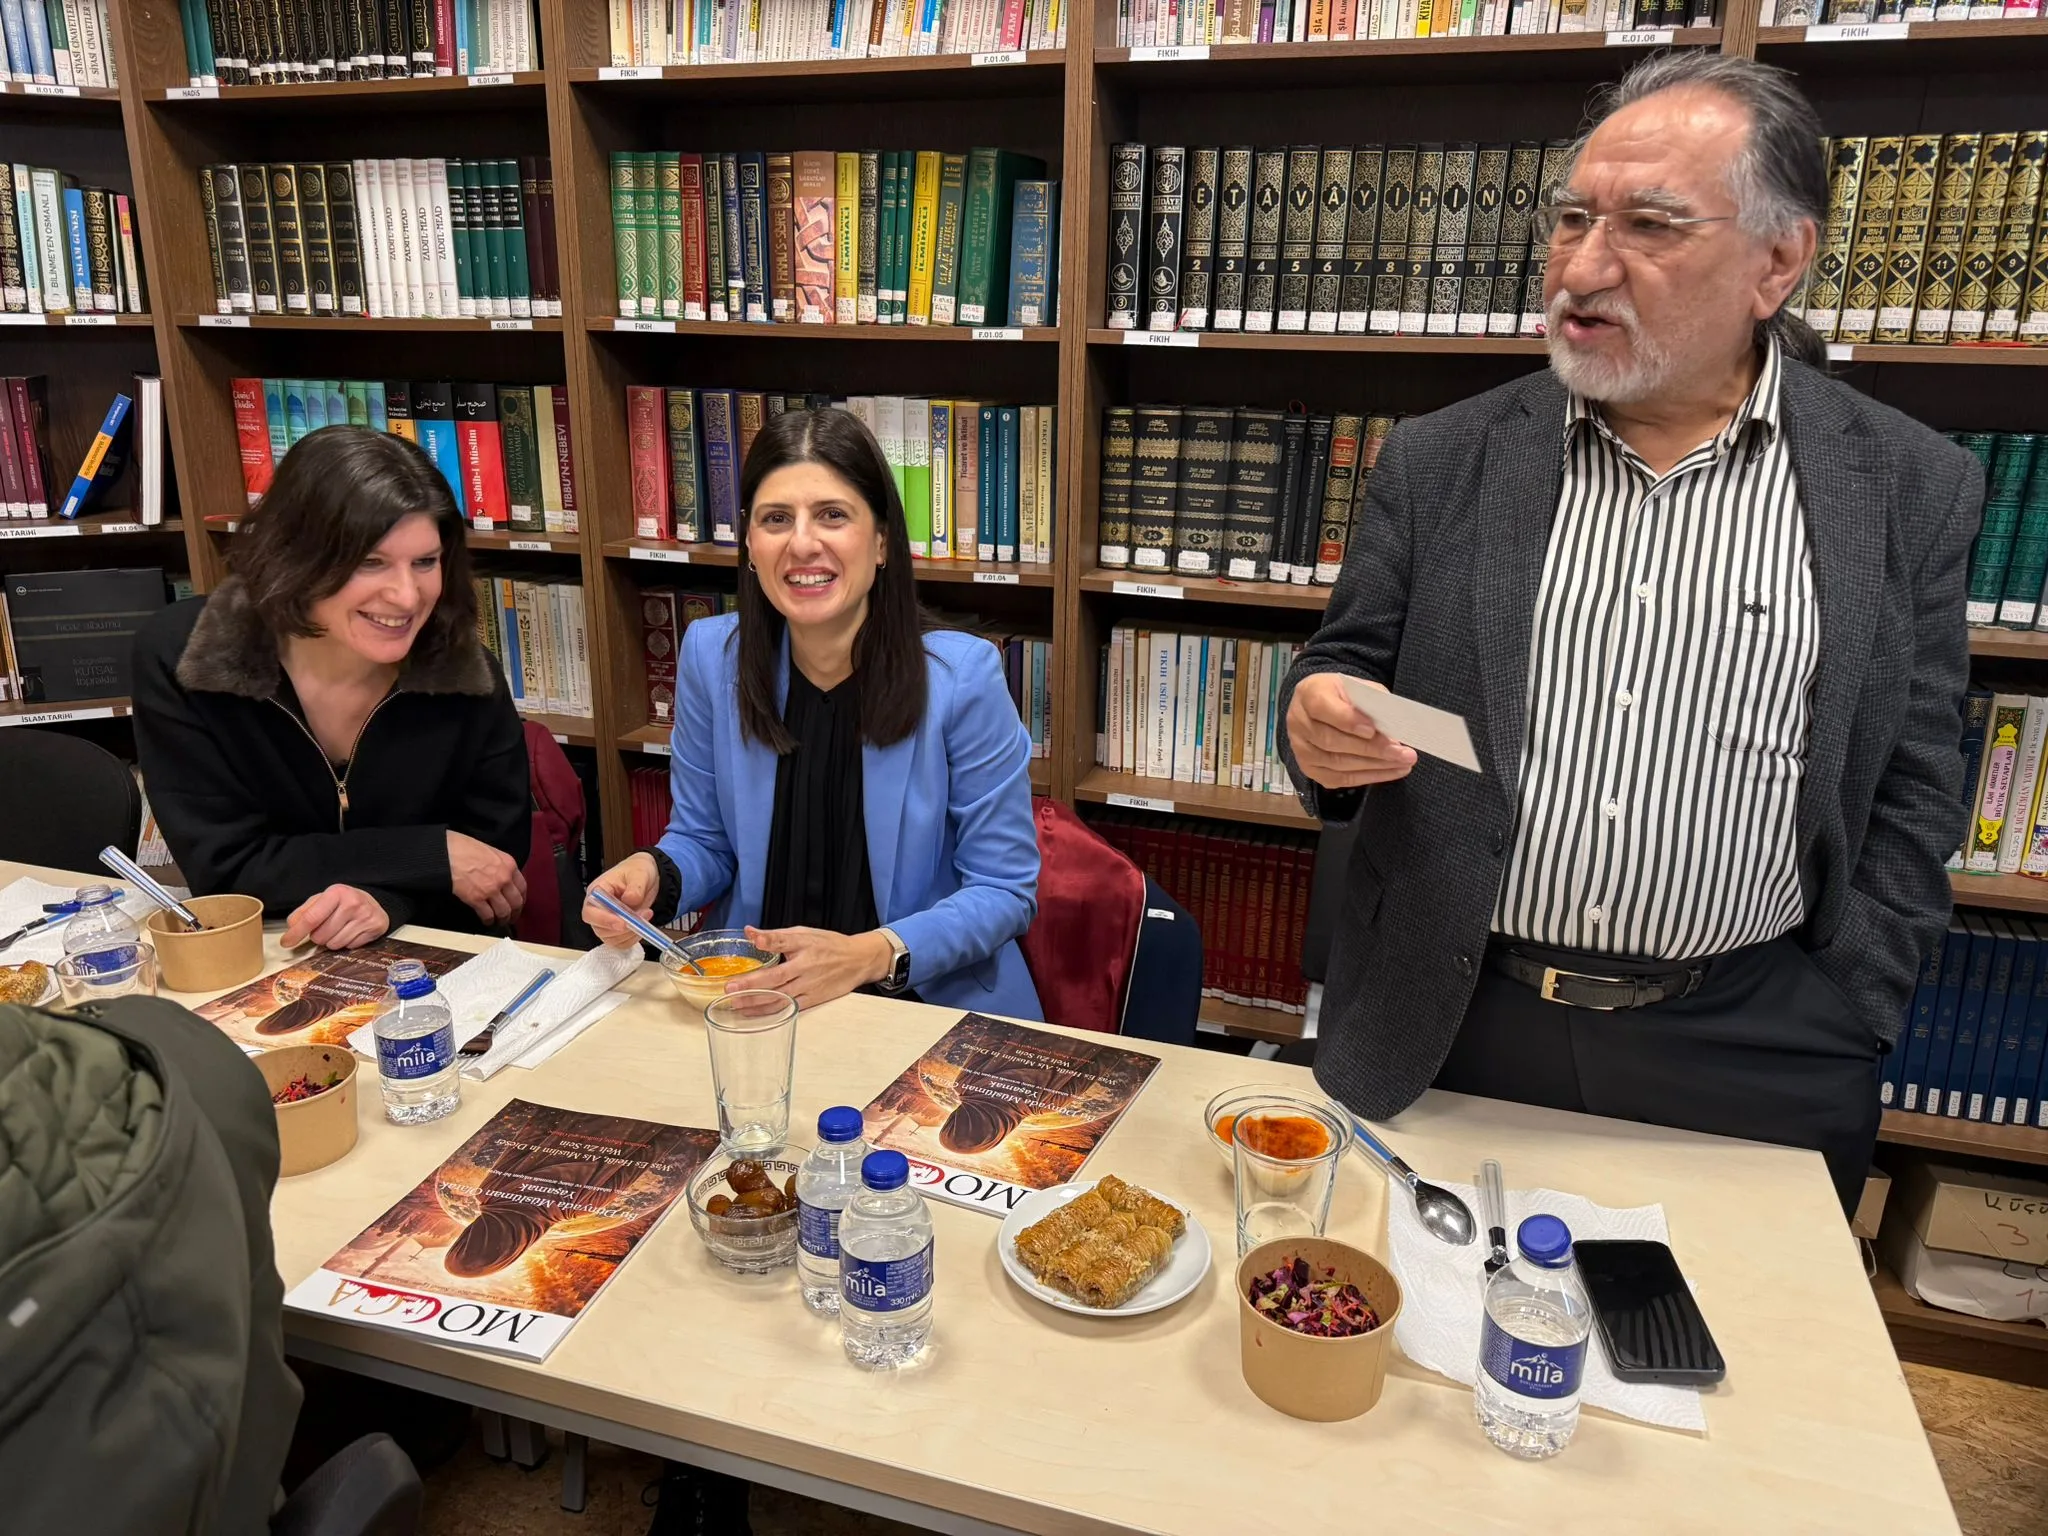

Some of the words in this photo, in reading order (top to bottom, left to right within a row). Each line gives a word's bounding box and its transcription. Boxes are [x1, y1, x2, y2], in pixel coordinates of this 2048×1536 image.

[83, 6, 96, 50] CİNAYETLER
[1841, 27, 1870, 38] FIKIH
[984, 55, 1010, 63] F.01.06
[1157, 49, 1180, 58] FIKIH
[88, 53, 99, 75] SİYASİ
[620, 69, 638, 77] FIKIH
[1197, 188, 1205, 205] E
[1230, 188, 1239, 205] T
[1261, 187, 1273, 207] Â
[1296, 191, 1308, 206] V
[1328, 186, 1340, 205] Â
[1360, 189, 1371, 206] Y
[1419, 191, 1431, 207] H
[1482, 189, 1495, 206] N
[1515, 188, 1527, 205] D
[41, 193, 52, 234] OSMANLI
[919, 206, 928, 272] İLMİHALİ
[45, 235, 58, 288] BİLİNMEYEN
[1192, 259, 1201, 270] 2
[1226, 259, 1235, 271] 3
[1256, 261, 1266, 272] 4
[1291, 261, 1300, 272] 5
[1323, 261, 1332, 272] 6
[1353, 261, 1363, 272] 7
[1385, 261, 1395, 273] 8
[1824, 259, 1836, 269] 14
[1863, 261, 1875, 271] 13
[1898, 258, 1910, 268] 12
[1936, 260, 1947, 270] 11
[1973, 260, 1986, 270] 10
[2009, 258, 2016, 268] 9
[1412, 264, 1422, 275] 9
[1441, 262, 1455, 274] 10
[1474, 262, 1486, 273] 11
[1504, 262, 1518, 274] 12
[1117, 298, 1124, 307] 3
[1159, 302, 1166, 311] 2
[635, 322, 652, 331] FIKIH
[978, 330, 1004, 339] F.01.05
[1149, 334, 1170, 344] FIKIH
[959, 452, 967, 479] Ticaret
[1025, 477, 1034, 532] MECELLE
[649, 551, 667, 559] FIKIH
[1136, 585, 1157, 594] FIKIH
[1159, 649, 1168, 678] FIKIH
[74, 664, 116, 677] KUTSAL
[21, 714, 46, 723] İSLAM
[46, 712, 73, 721] TARİHİ
[1994, 792, 2006, 818] BÜYÜK
[2000, 749, 2013, 791] SEVAPLAR
[1129, 798, 1149, 807] FIKIH
[1985, 832, 1993, 841] 2
[1258, 964, 1265, 976] 8
[960, 1043, 990, 1056] Dieser
[991, 1050, 1001, 1058] In
[1015, 1049, 1033, 1058] Sein
[397, 1052, 436, 1068] mila
[1002, 1053, 1038, 1067] Muslim
[1050, 1058, 1070, 1068] Welt
[1039, 1062, 1055, 1071] Als
[1084, 1072, 1094, 1080] Es
[1098, 1075, 1117, 1086] Was
[961, 1083, 1022, 1105] Müslüman
[990, 1080, 1039, 1098] Yaşamak
[1024, 1098, 1077, 1116] Dünyada
[1079, 1111, 1097, 1121] Bu
[494, 1138, 528, 1151] Dieser
[529, 1144, 540, 1152] In
[559, 1140, 580, 1149] Sein
[543, 1146, 580, 1160] Muslim
[601, 1146, 622, 1156] Welt
[583, 1152, 602, 1162] Als
[604, 1154, 631, 1167] Heißt,
[633, 1159, 646, 1169] Es
[650, 1161, 673, 1172] Was
[439, 1180, 483, 1197] Olarak
[520, 1182, 576, 1200] Yaşamak
[485, 1188, 551, 1208] Müslüman
[556, 1199, 616, 1219] Dünyada
[619, 1209, 639, 1221] Bu
[1996, 1222, 2030, 1246] 3
[845, 1274, 886, 1297] mila
[890, 1297, 905, 1306] 330
[1510, 1361, 1565, 1385] mila
